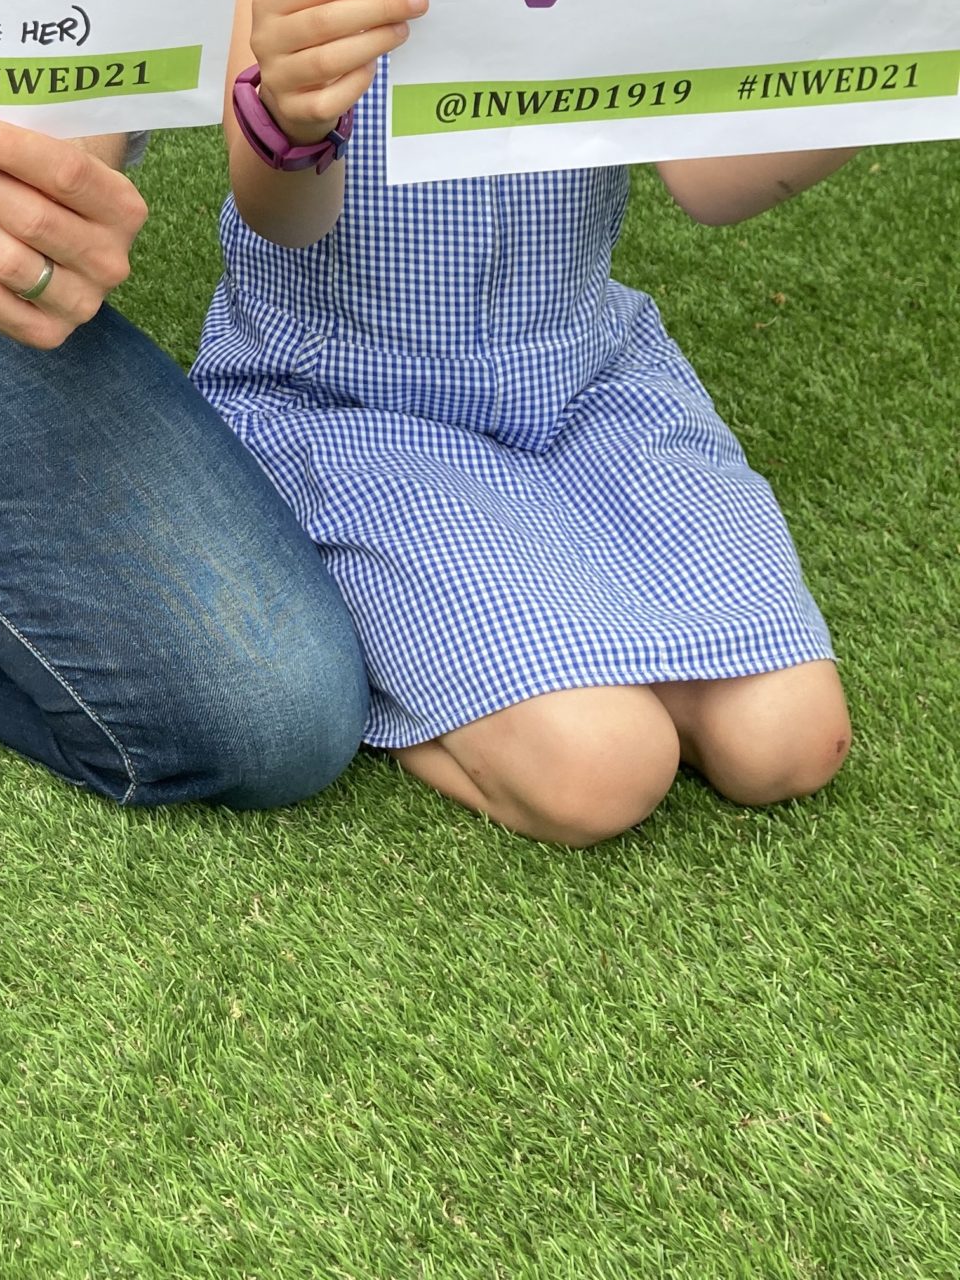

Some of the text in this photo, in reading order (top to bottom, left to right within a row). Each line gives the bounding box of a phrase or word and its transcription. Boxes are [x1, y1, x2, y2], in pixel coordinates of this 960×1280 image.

[21, 5, 90, 46] HER)
[435, 63, 919, 123] @INWED1919 #INWED21
